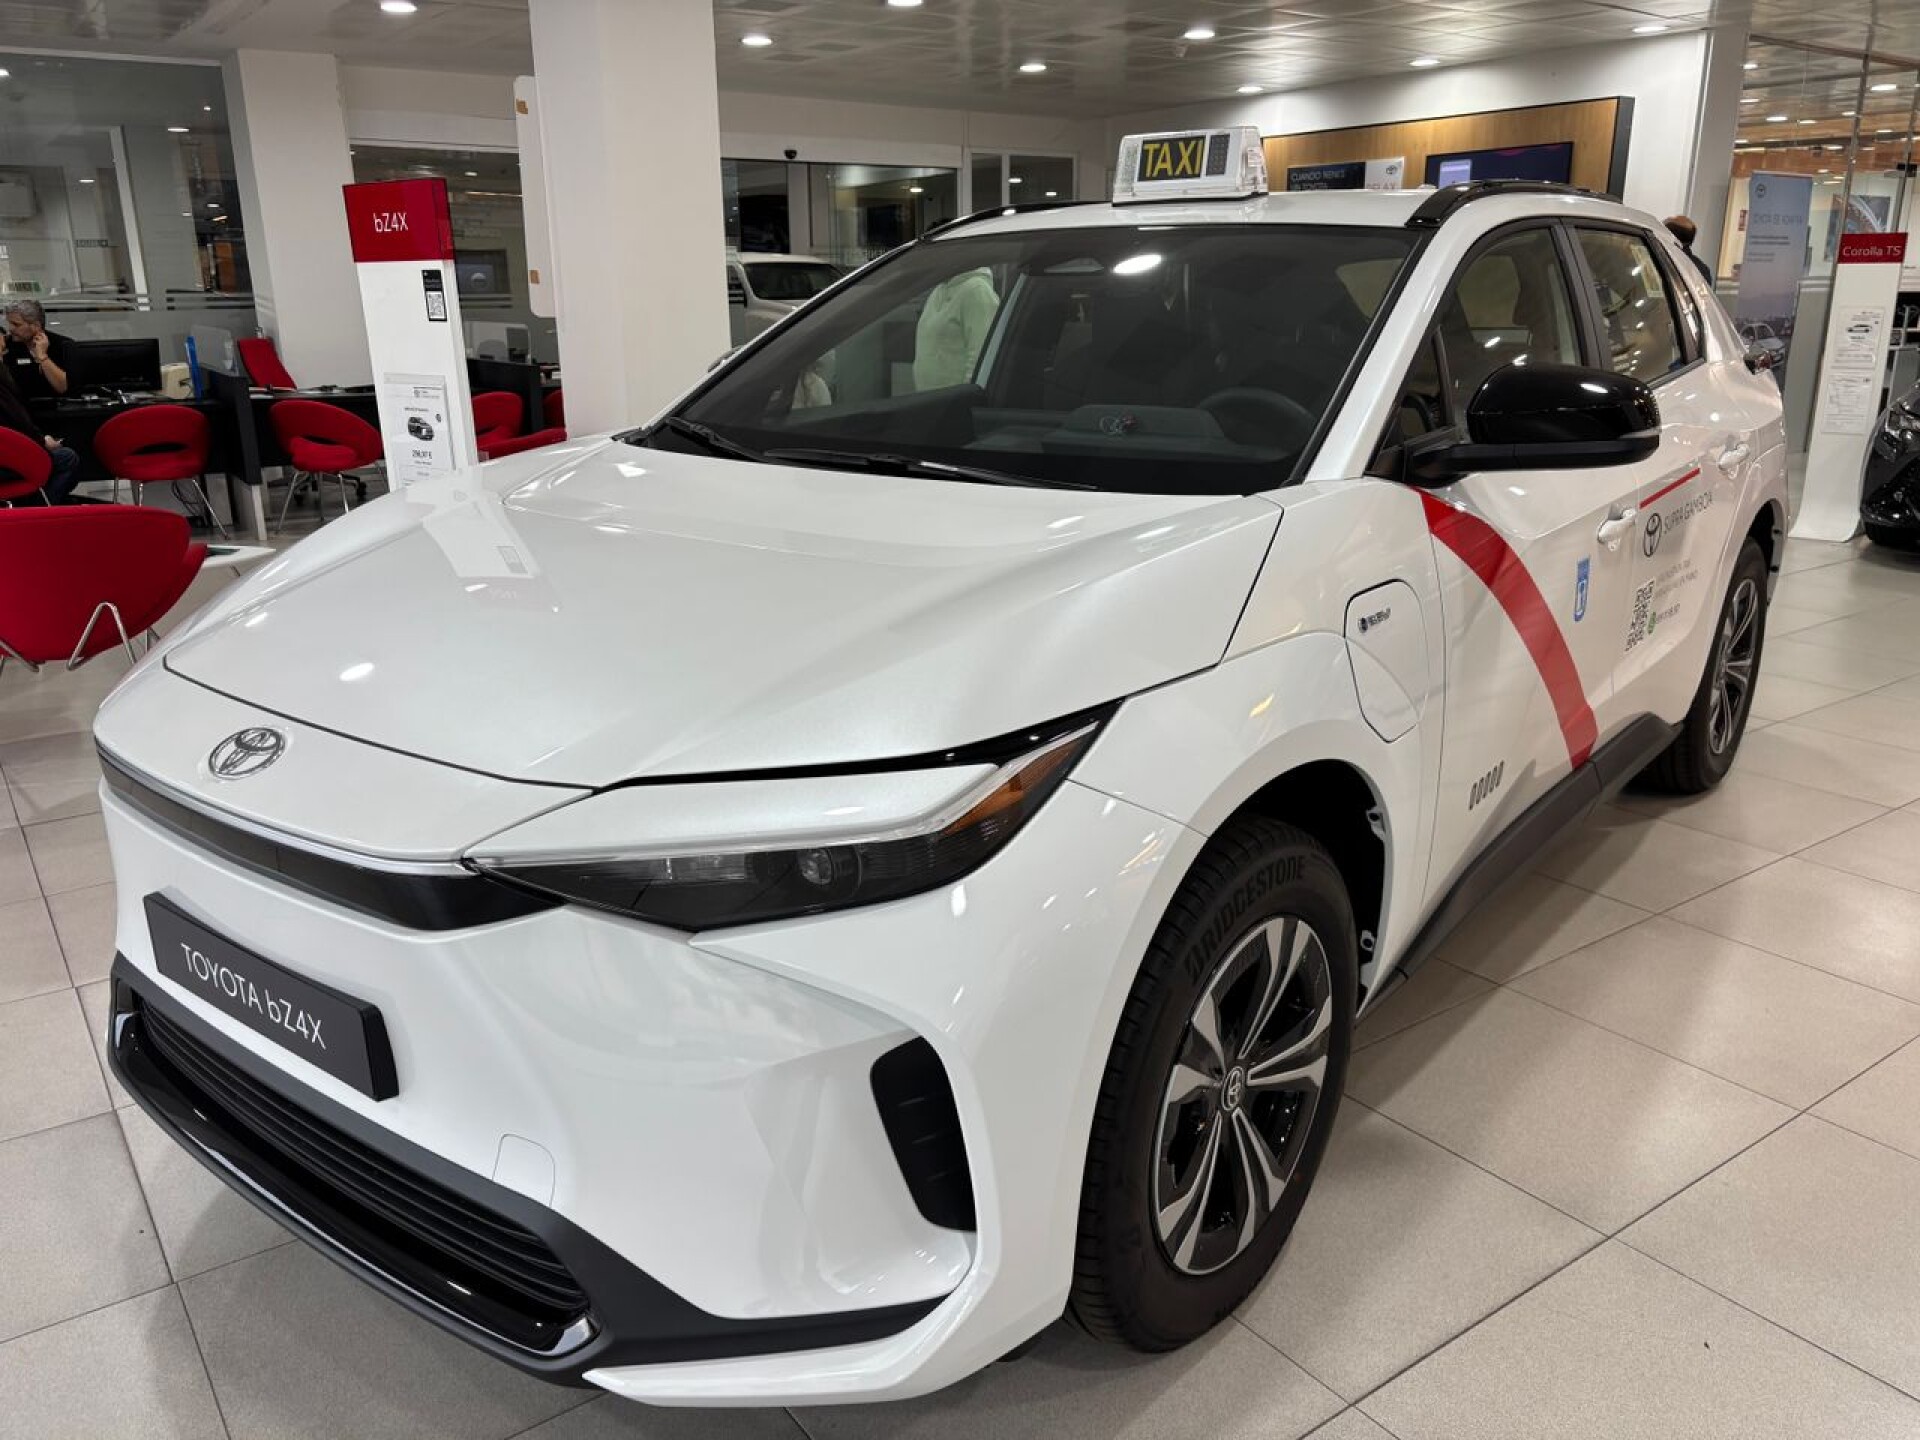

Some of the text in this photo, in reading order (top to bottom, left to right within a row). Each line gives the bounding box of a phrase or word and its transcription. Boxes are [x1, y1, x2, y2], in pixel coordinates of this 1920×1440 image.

[1142, 139, 1204, 178] TAXI
[372, 212, 409, 232] bZ4X
[1843, 245, 1902, 257] Corolla TS
[1183, 855, 1307, 987] BRIDGESTONE
[180, 942, 327, 1050] TOYOTA bZ4X
